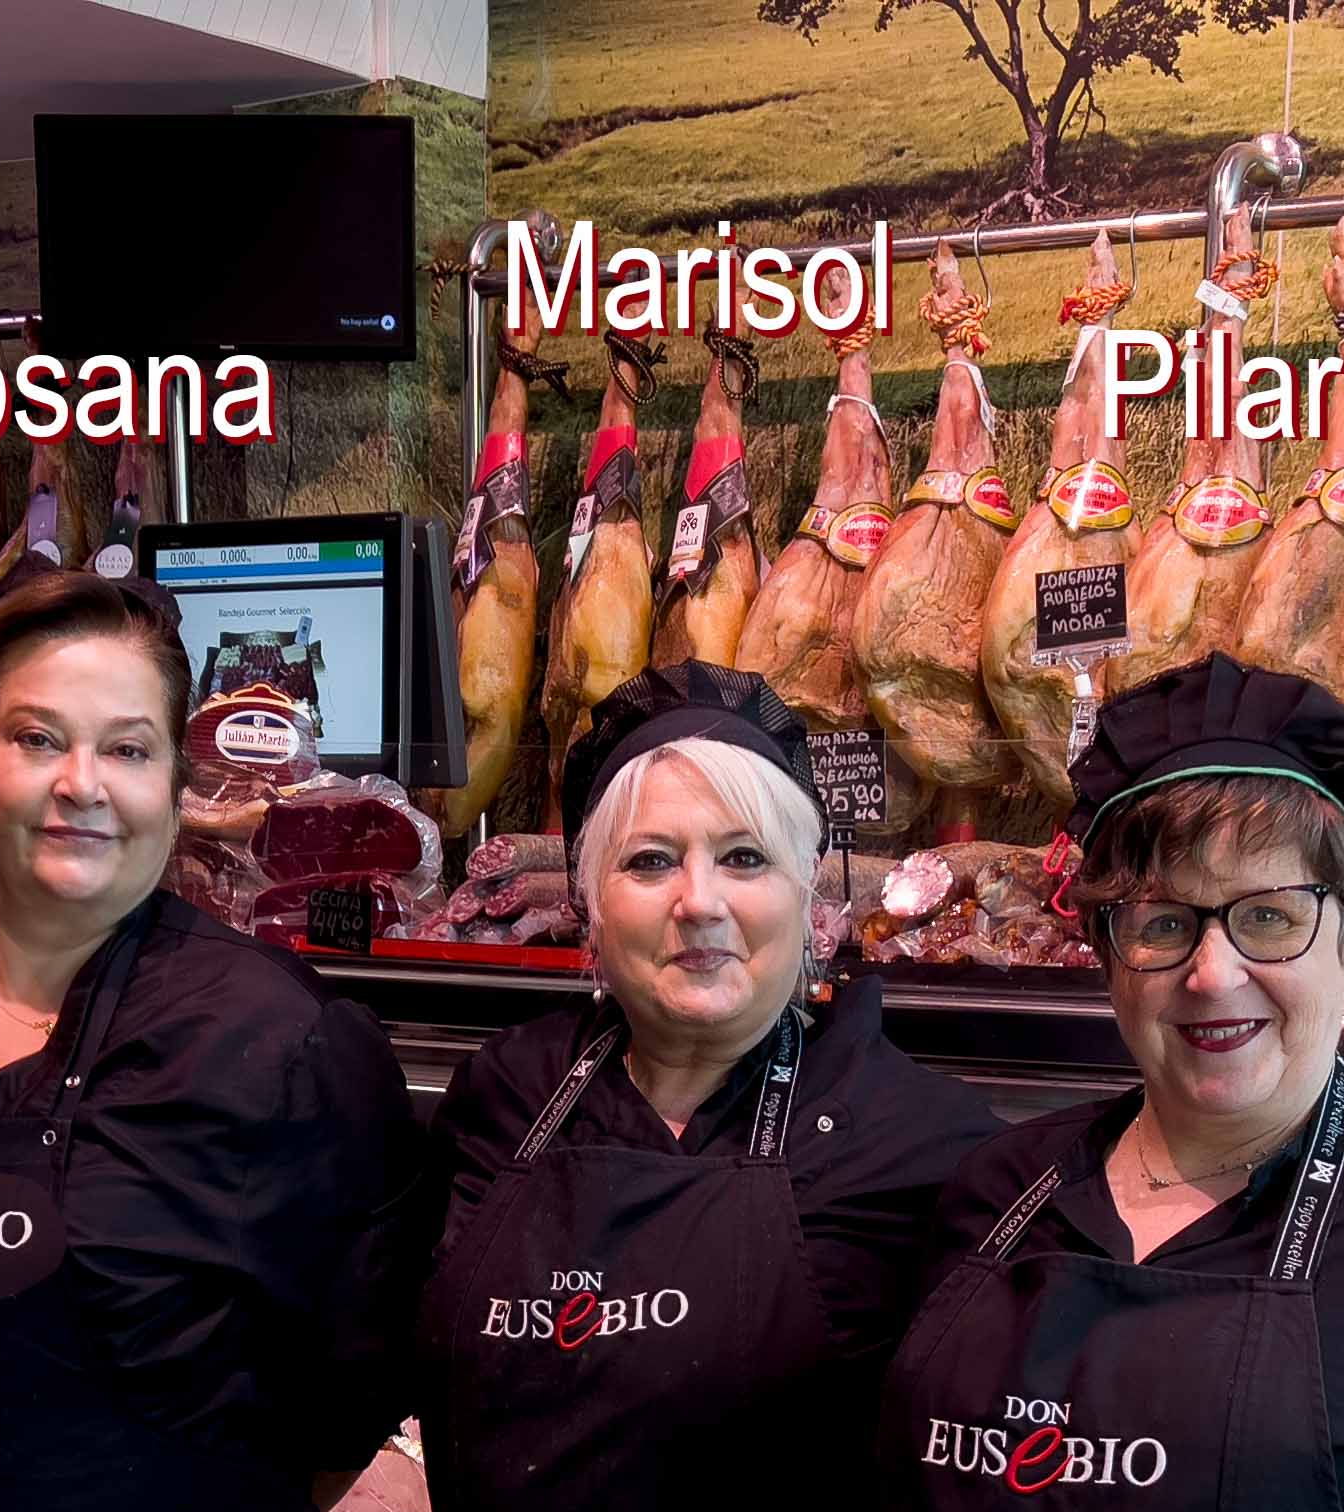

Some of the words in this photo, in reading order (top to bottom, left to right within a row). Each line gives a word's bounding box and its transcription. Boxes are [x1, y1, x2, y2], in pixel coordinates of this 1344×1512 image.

[1043, 581, 1117, 608] RUBIELOS
[1070, 601, 1087, 614] DE
[223, 728, 255, 745] Julián
[550, 1270, 604, 1292] DON
[1003, 1395, 1072, 1425] DON
